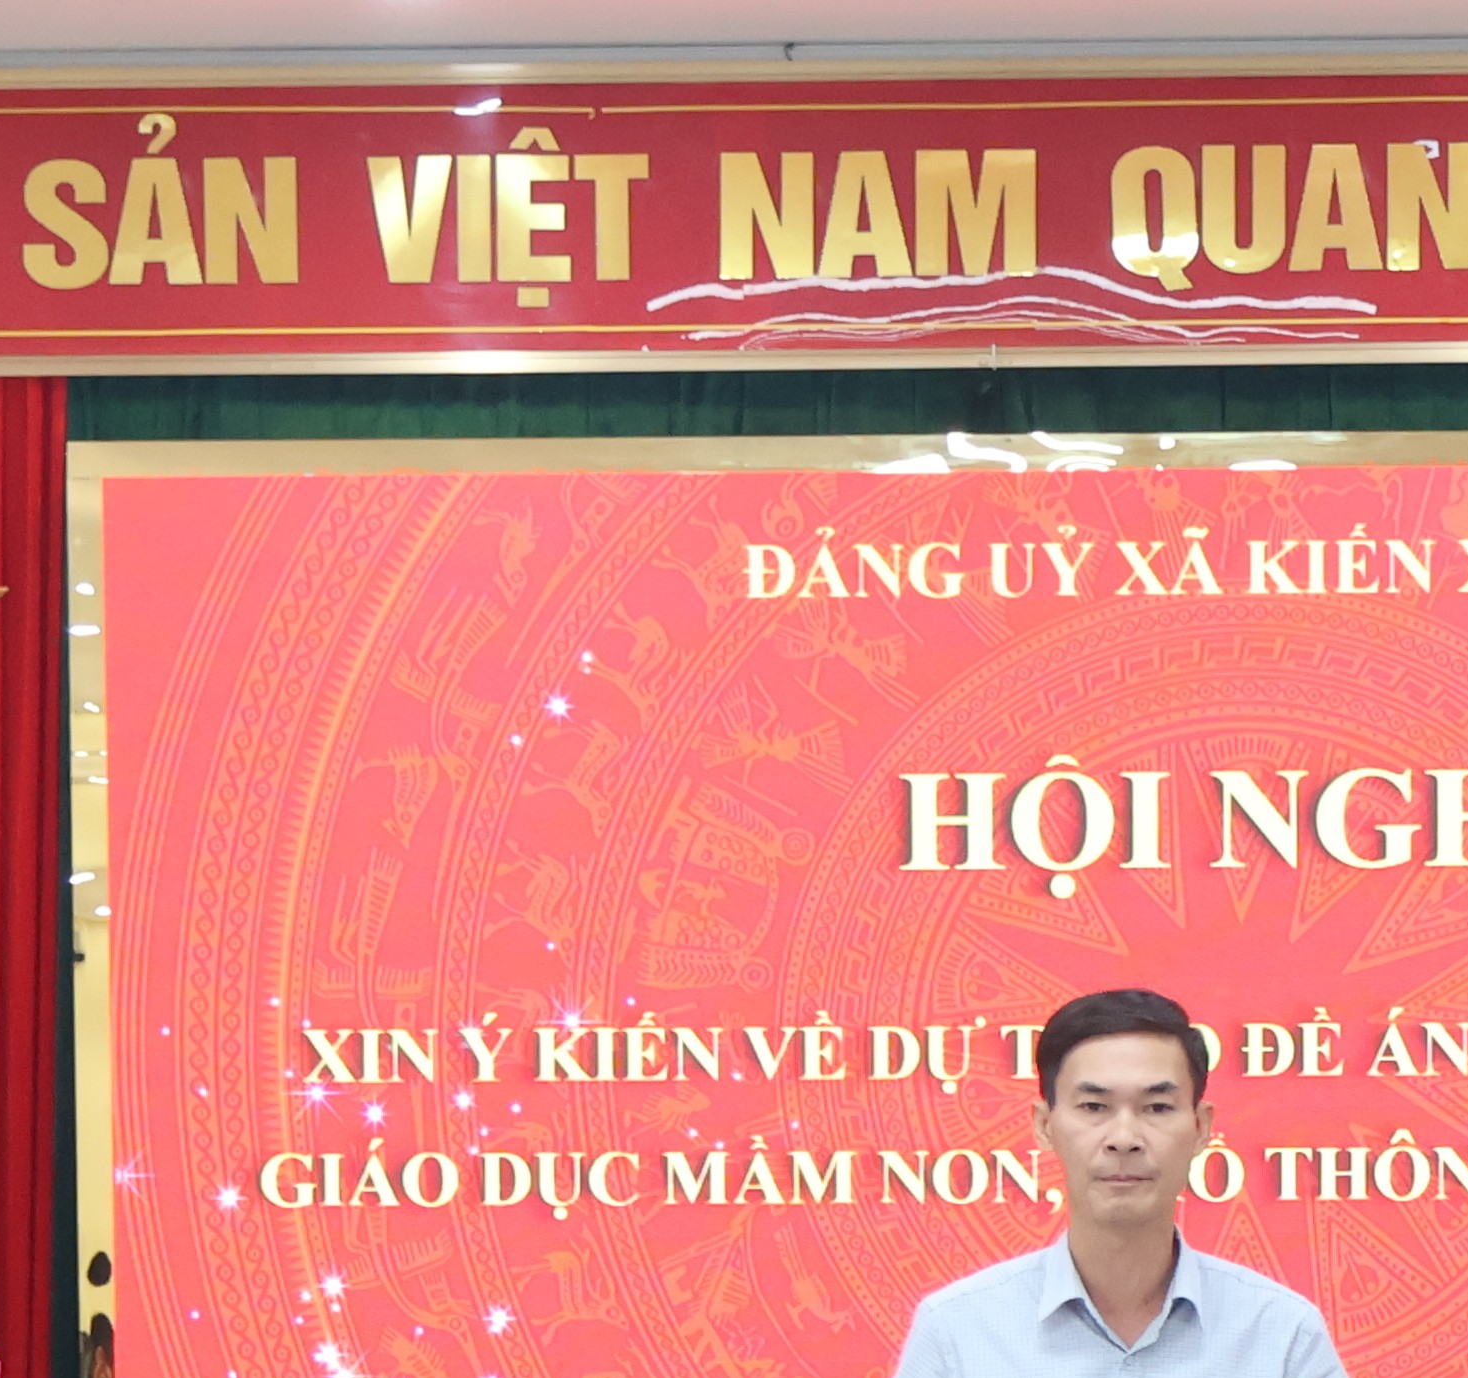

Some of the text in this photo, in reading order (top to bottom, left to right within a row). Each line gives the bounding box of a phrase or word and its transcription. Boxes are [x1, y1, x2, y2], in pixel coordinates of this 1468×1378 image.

[22, 113, 299, 290] SẢN
[368, 127, 649, 308] VIỆT
[720, 148, 1037, 282] NAM
[743, 527, 964, 599] ĐẢNG
[989, 525, 1095, 598] UỶ
[1115, 526, 1224, 596] XÃ
[1247, 523, 1435, 595] KIẾN
[899, 754, 1171, 899] HỘI
[303, 1025, 438, 1082] XIN
[457, 1012, 512, 1082] Ý
[535, 1012, 723, 1082] KIẾN
[747, 1010, 846, 1081] VỀ
[869, 1016, 987, 1094] DỰ
[1240, 1006, 1343, 1076] ĐỀ
[260, 1138, 459, 1209] GIÁO
[481, 1152, 639, 1220] DỤC
[664, 1136, 856, 1206] MẦM
[879, 1149, 1064, 1213] NON,
